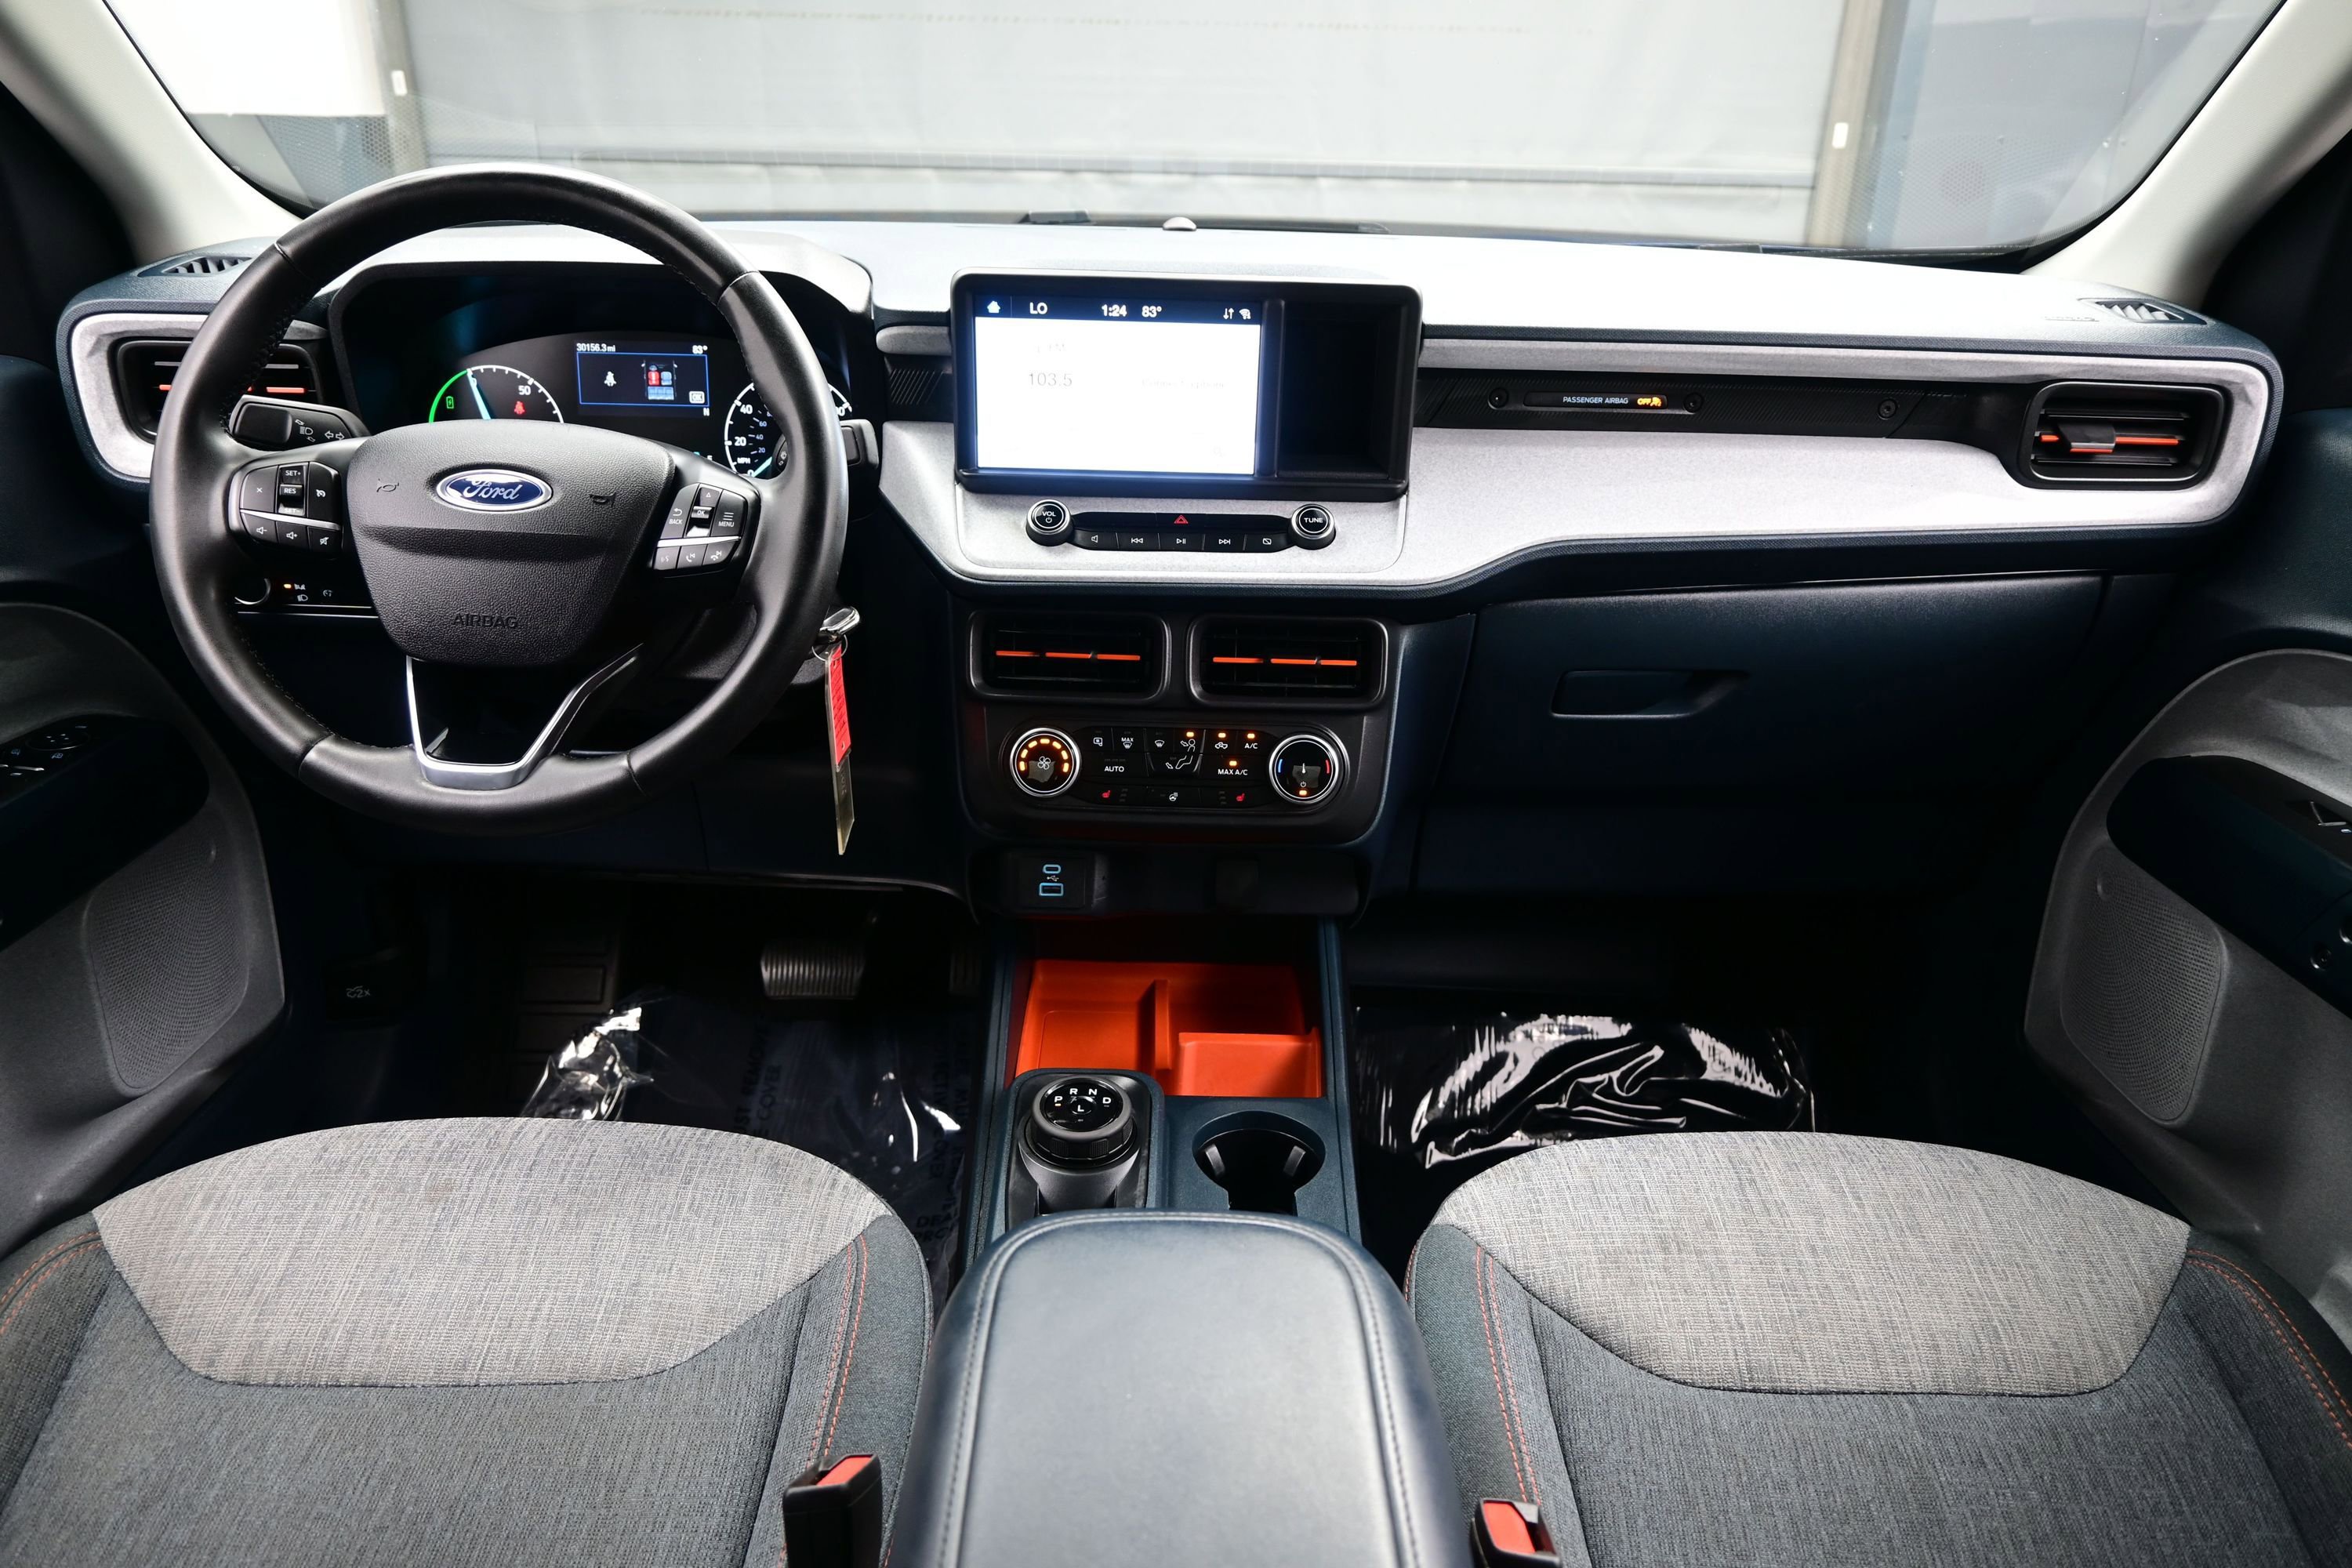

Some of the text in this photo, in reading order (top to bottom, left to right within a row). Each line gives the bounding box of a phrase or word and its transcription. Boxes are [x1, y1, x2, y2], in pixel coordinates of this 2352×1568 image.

[1029, 302, 1047, 314] LO
[1102, 304, 1127, 317] 1:24
[1029, 372, 1073, 387] 103.5
[518, 386, 531, 395] 50
[740, 405, 753, 414] 40
[735, 436, 747, 446] 20
[463, 478, 523, 500] Ford
[453, 614, 518, 628] AIRBAG
